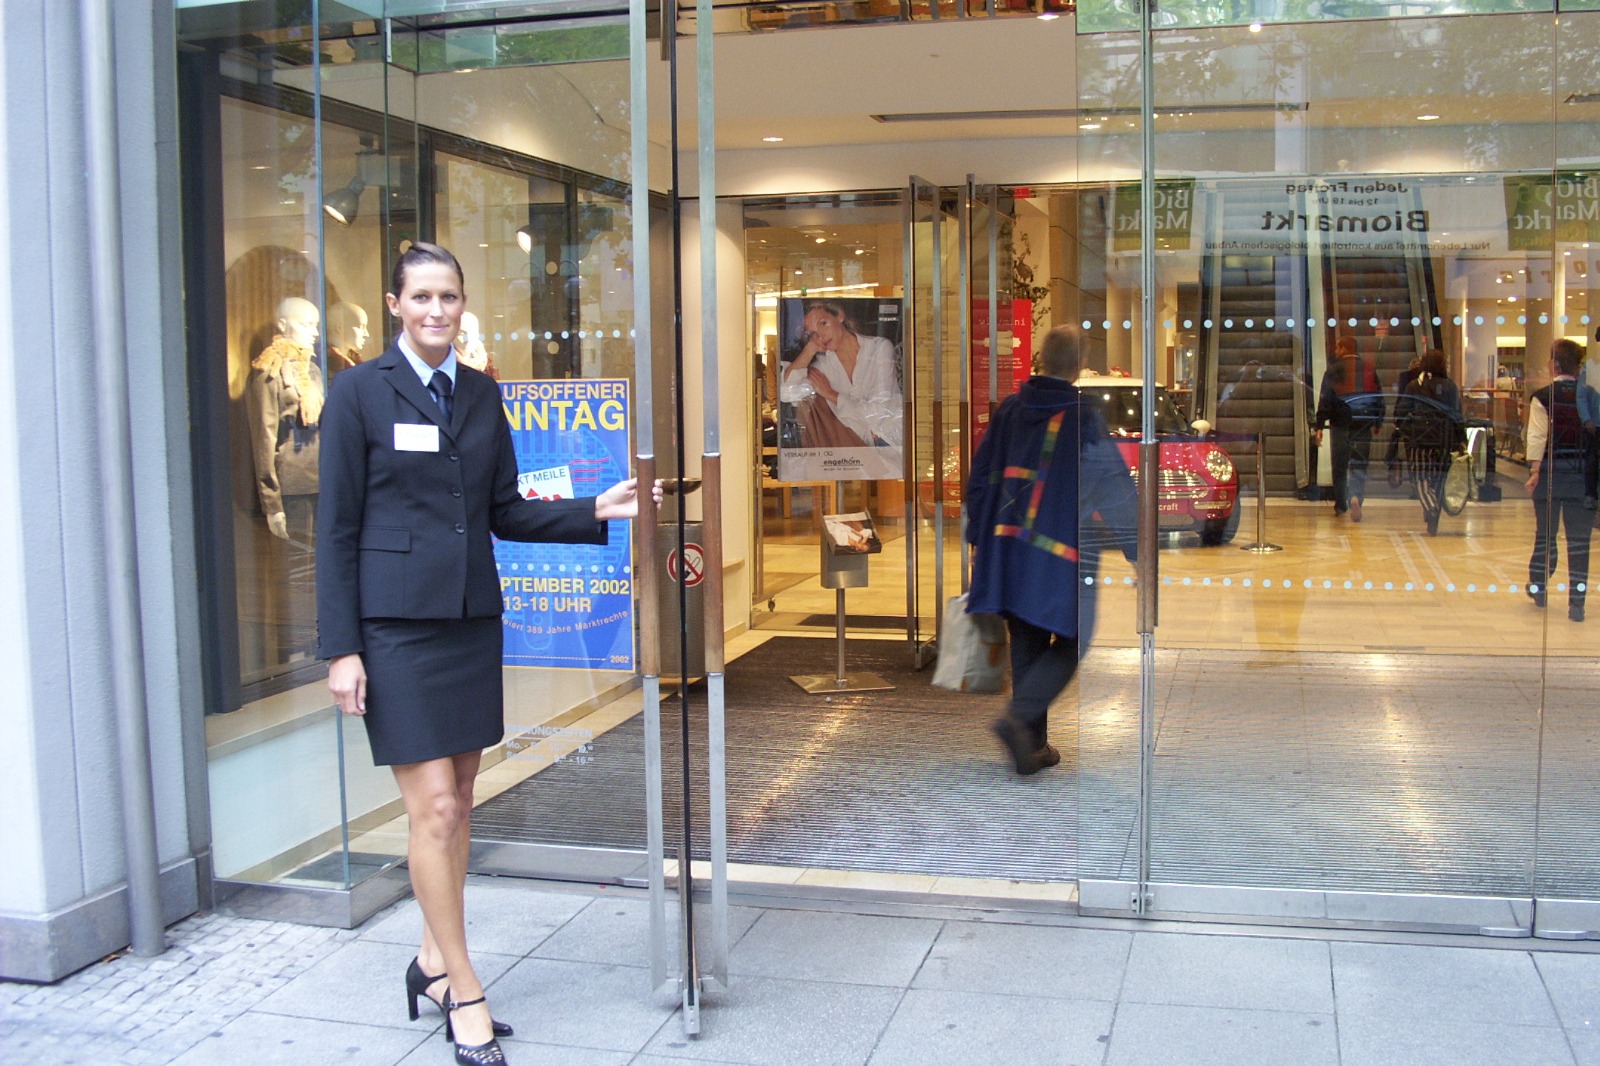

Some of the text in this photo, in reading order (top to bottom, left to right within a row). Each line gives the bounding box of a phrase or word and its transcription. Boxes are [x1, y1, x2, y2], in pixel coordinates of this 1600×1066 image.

[502, 383, 625, 400] UFSOFFENER
[503, 399, 625, 431] NNTAG
[518, 467, 567, 485] KT MEILE
[1158, 502, 1178, 511] craft
[500, 576, 630, 595] PTEMBER 2002
[504, 595, 592, 613] 13-18 UHR
[526, 625, 543, 634] 389
[546, 624, 572, 634] Jahre
[574, 610, 629, 631] Marktrechte
[610, 655, 630, 664] 2002
